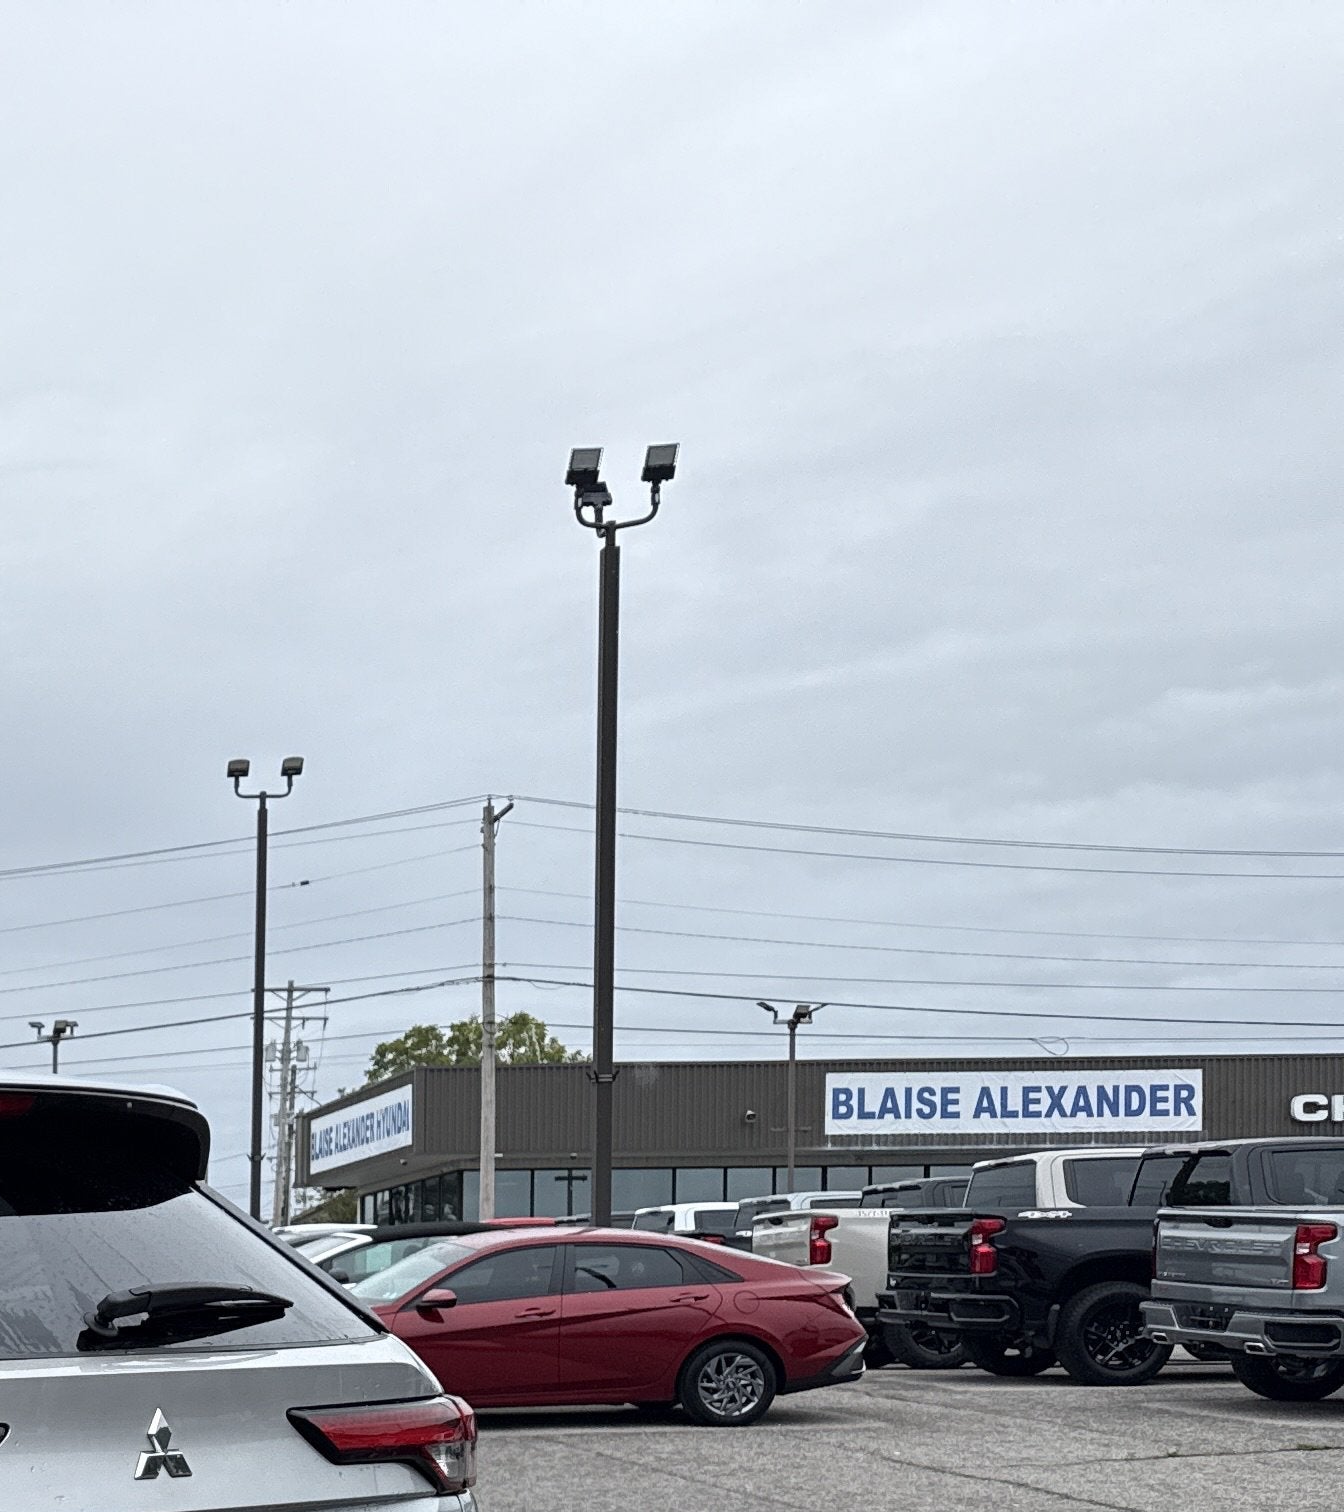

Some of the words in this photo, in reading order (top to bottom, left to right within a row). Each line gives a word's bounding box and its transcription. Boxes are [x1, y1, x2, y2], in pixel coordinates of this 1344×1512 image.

[832, 1086, 960, 1120] BLAISE
[972, 1083, 1197, 1119] ALEXANDER
[311, 1126, 333, 1160] BLAISE
[334, 1112, 375, 1154] ALEXANDER
[376, 1099, 410, 1141] HYUNDAI
